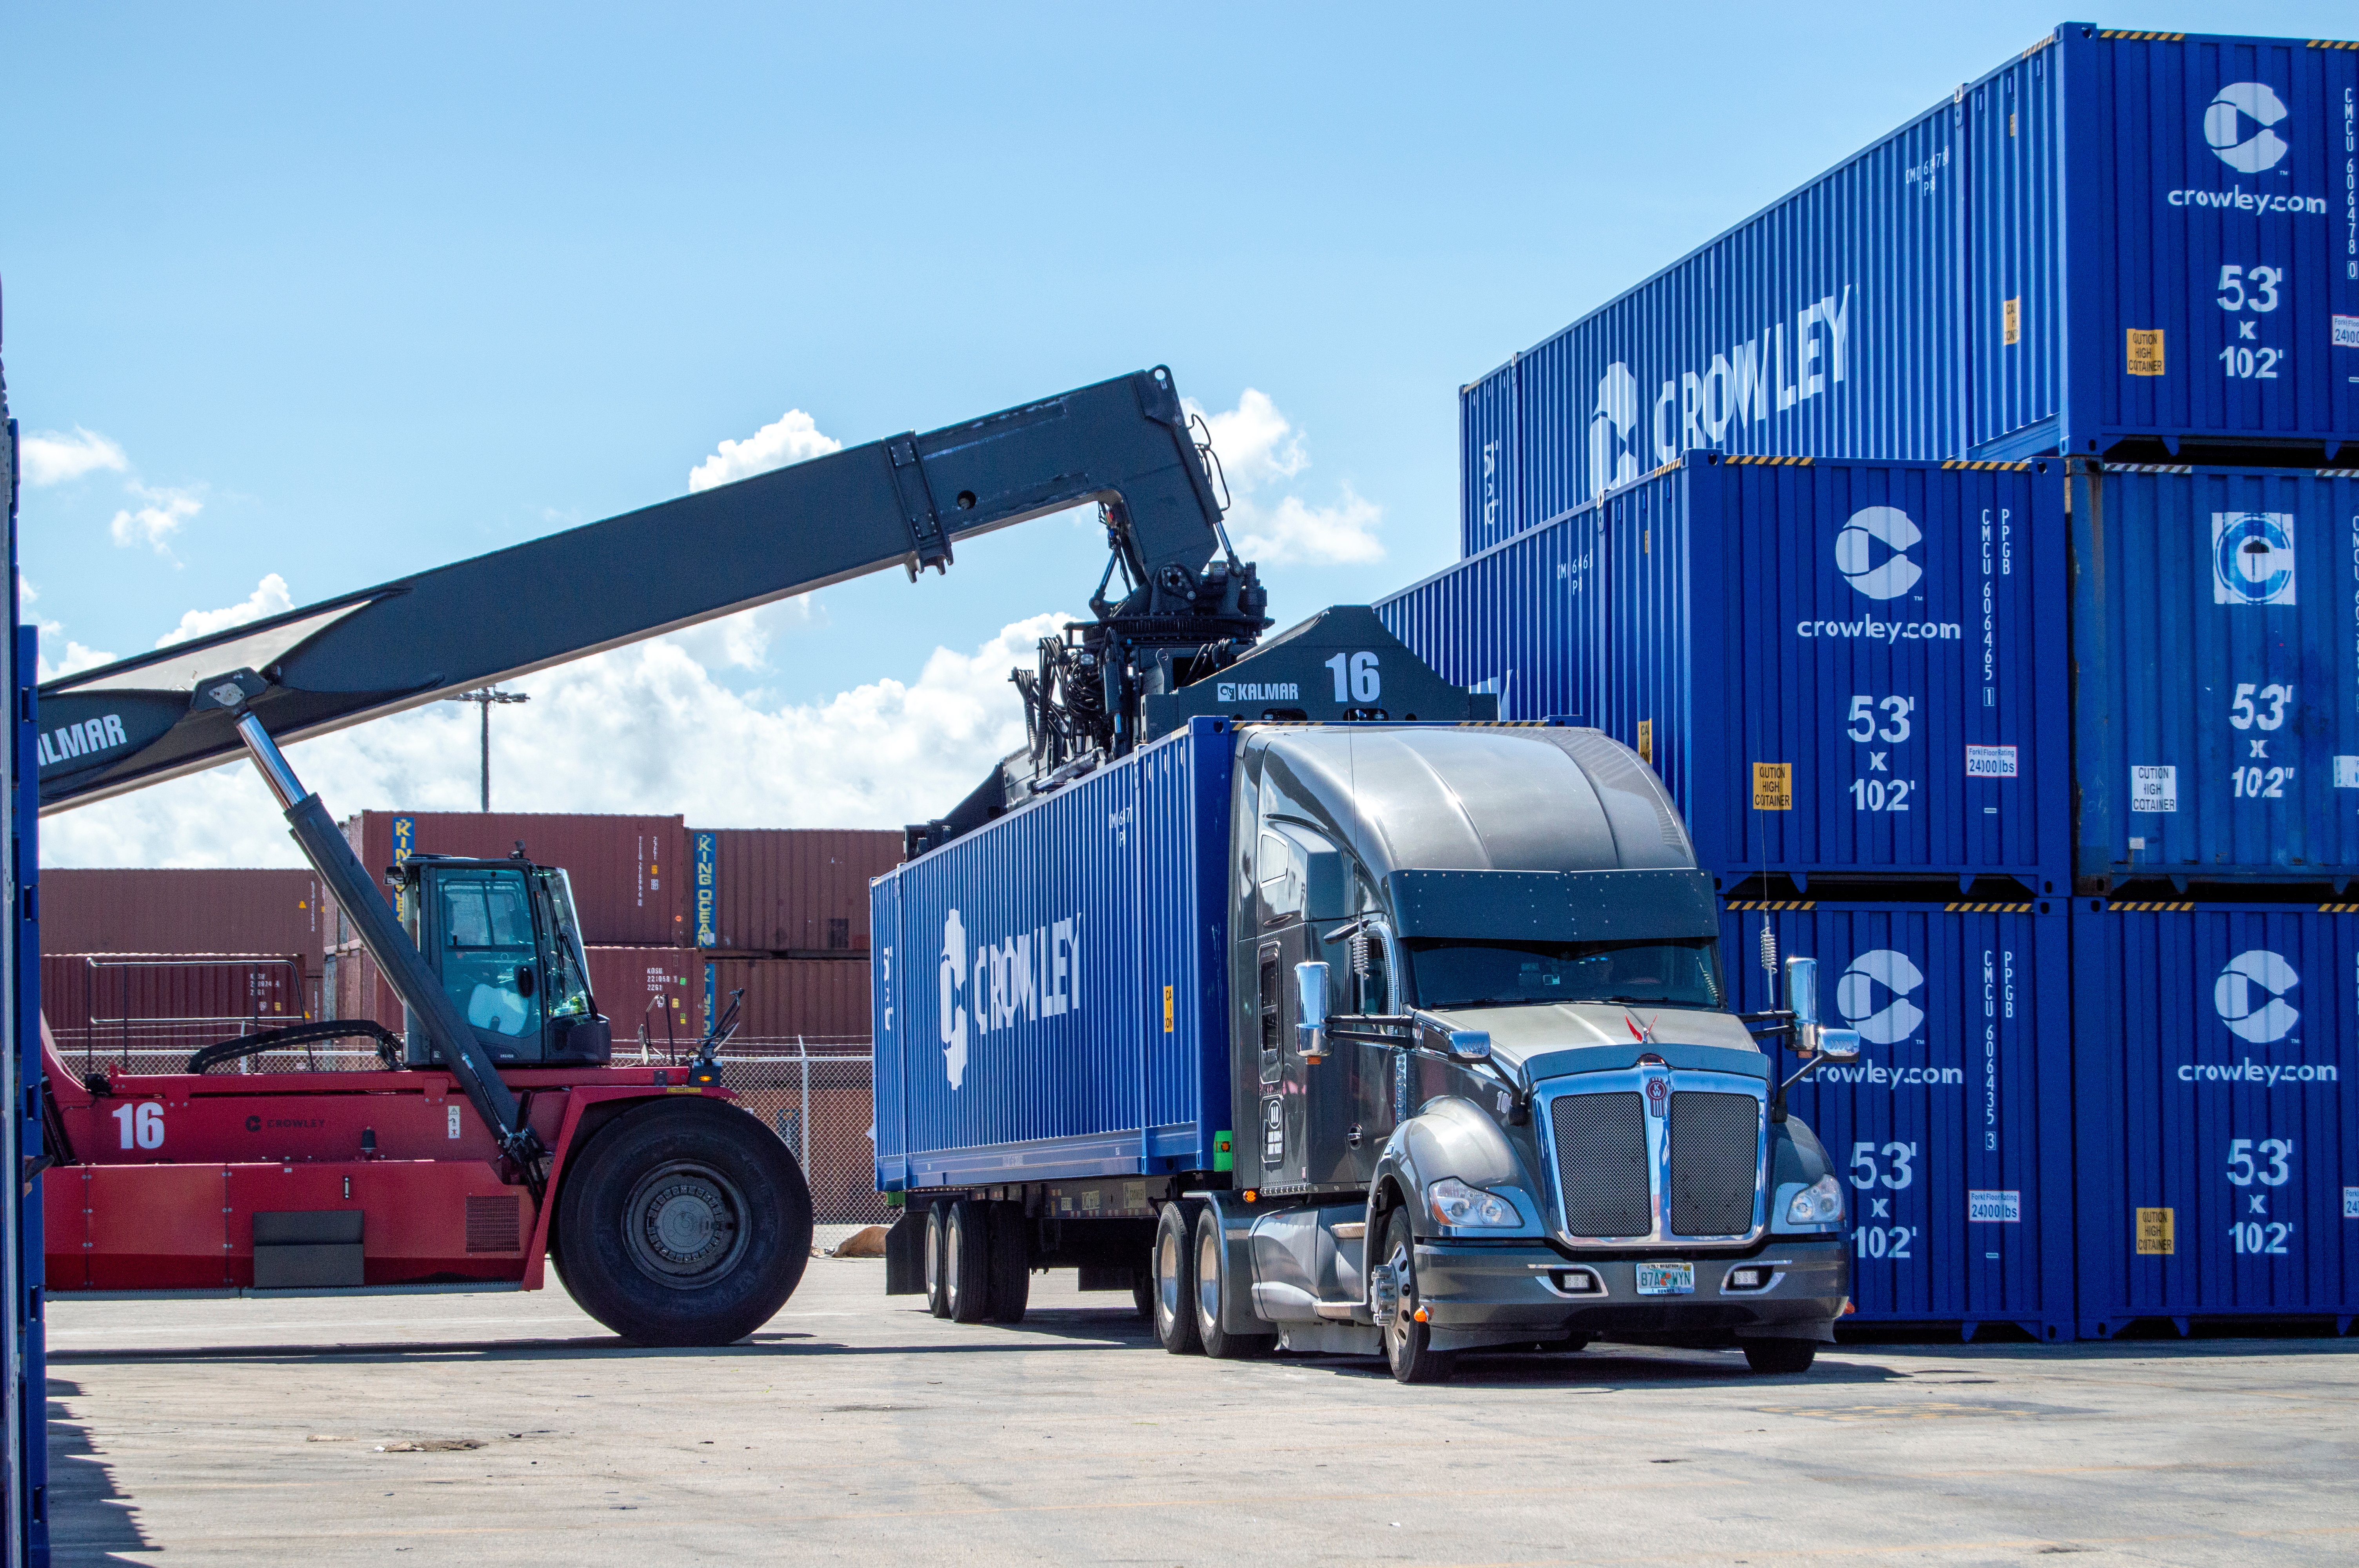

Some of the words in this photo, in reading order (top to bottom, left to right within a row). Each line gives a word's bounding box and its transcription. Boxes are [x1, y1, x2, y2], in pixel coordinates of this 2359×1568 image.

[2345, 87, 2354, 152] CMCU
[2168, 184, 2326, 215] crowley.com
[2347, 158, 2356, 255] 606478
[2217, 264, 2283, 312] 53'
[1654, 283, 1852, 462] CROWLEY
[2219, 345, 2283, 378] 102'
[1982, 508, 1991, 575] CMCU
[2001, 508, 2010, 575] PPGB
[1797, 613, 1961, 644] crowley.com
[1983, 581, 1993, 681] 606465
[1238, 683, 1299, 701] KALMAR
[1325, 651, 1381, 702] 16
[1847, 695, 1915, 743] 53'
[2229, 683, 2294, 731] 53'
[37, 714, 127, 766] LMAR
[1763, 780, 1780, 792] HIGH
[1850, 778, 1915, 811] 102'
[698, 835, 712, 885] KING
[974, 912, 1081, 1035] CROWLEY
[1984, 950, 1994, 1017] CMCU
[2005, 951, 2014, 1018] PPGB
[1986, 1024, 1995, 1125] 606435
[2177, 1057, 2337, 1087] crowley.com
[112, 1102, 164, 1149] 16
[267, 1119, 325, 1128] CROWLEY
[1849, 1141, 1917, 1190] 53'
[2226, 1138, 2292, 1186] 53'
[1851, 1226, 1917, 1258] 102'
[2228, 1221, 2293, 1254] 102'
